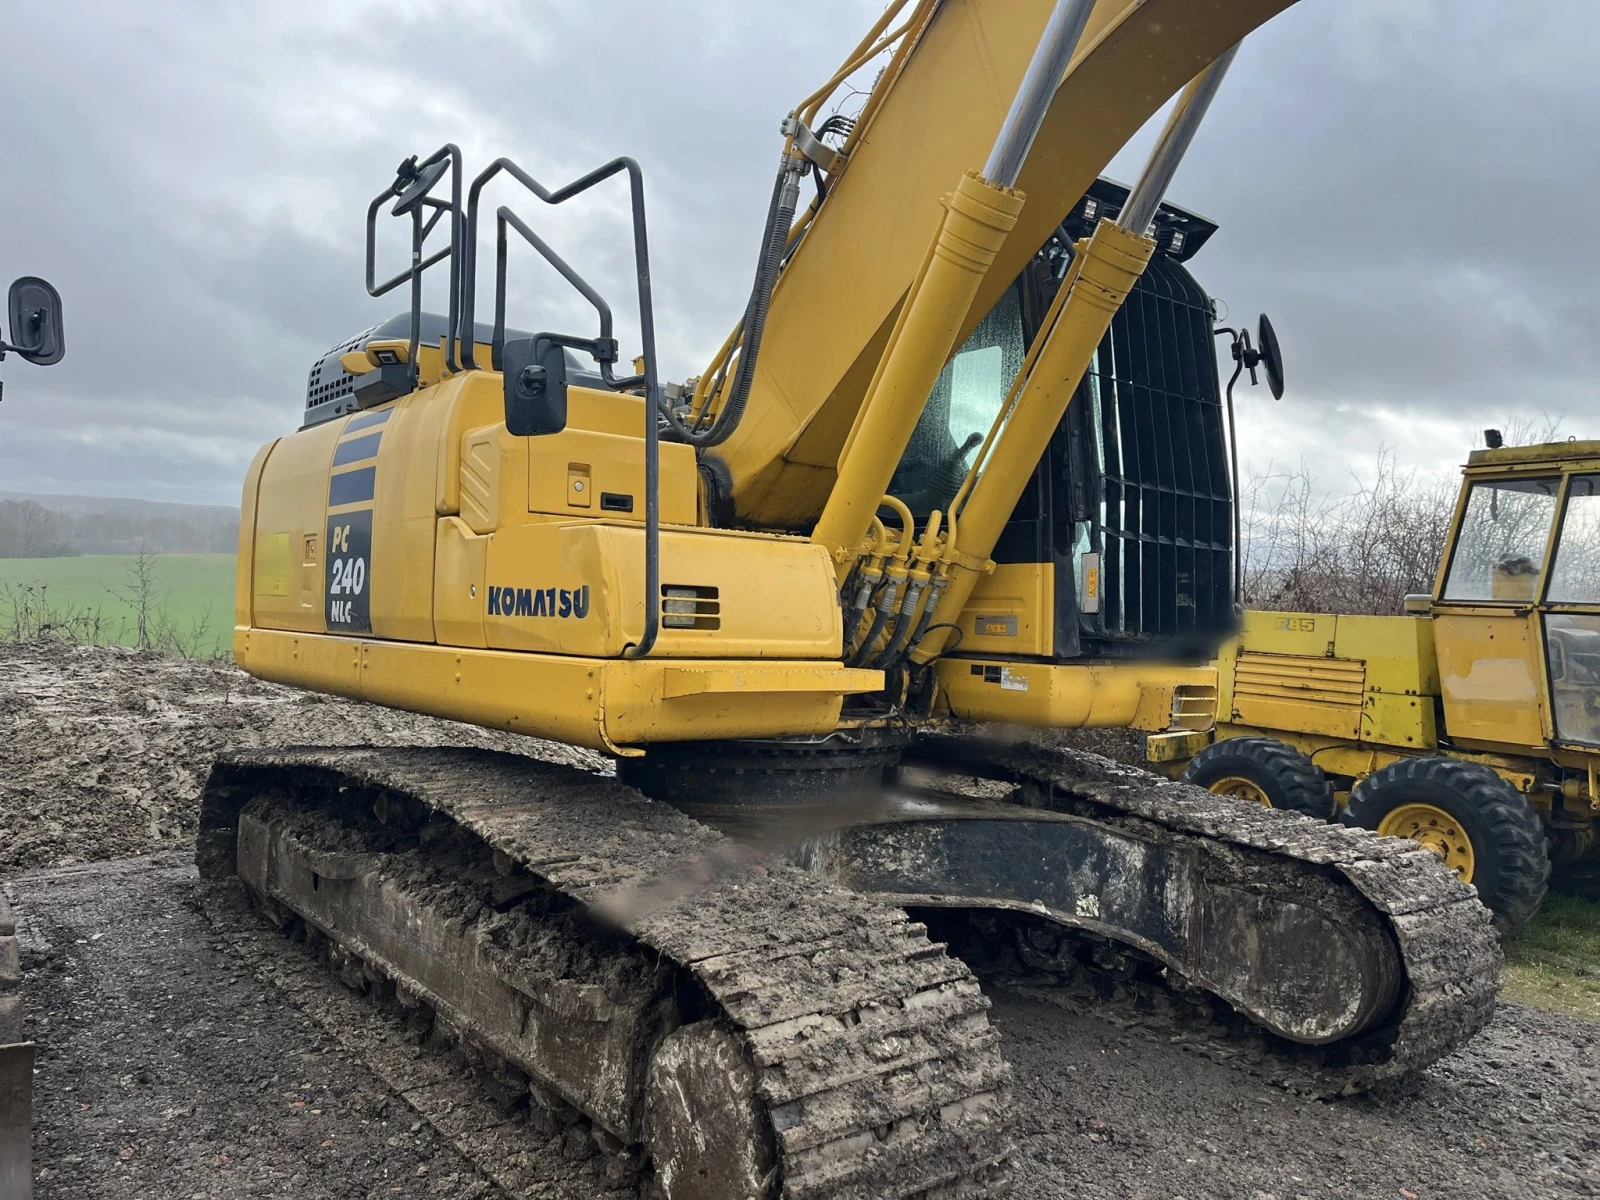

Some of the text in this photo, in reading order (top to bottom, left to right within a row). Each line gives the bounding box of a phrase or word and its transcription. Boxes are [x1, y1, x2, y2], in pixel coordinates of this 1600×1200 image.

[332, 525, 350, 553] PC
[330, 557, 365, 595] 240
[331, 601, 352, 623] NLC
[488, 585, 590, 619] KOMATSU
